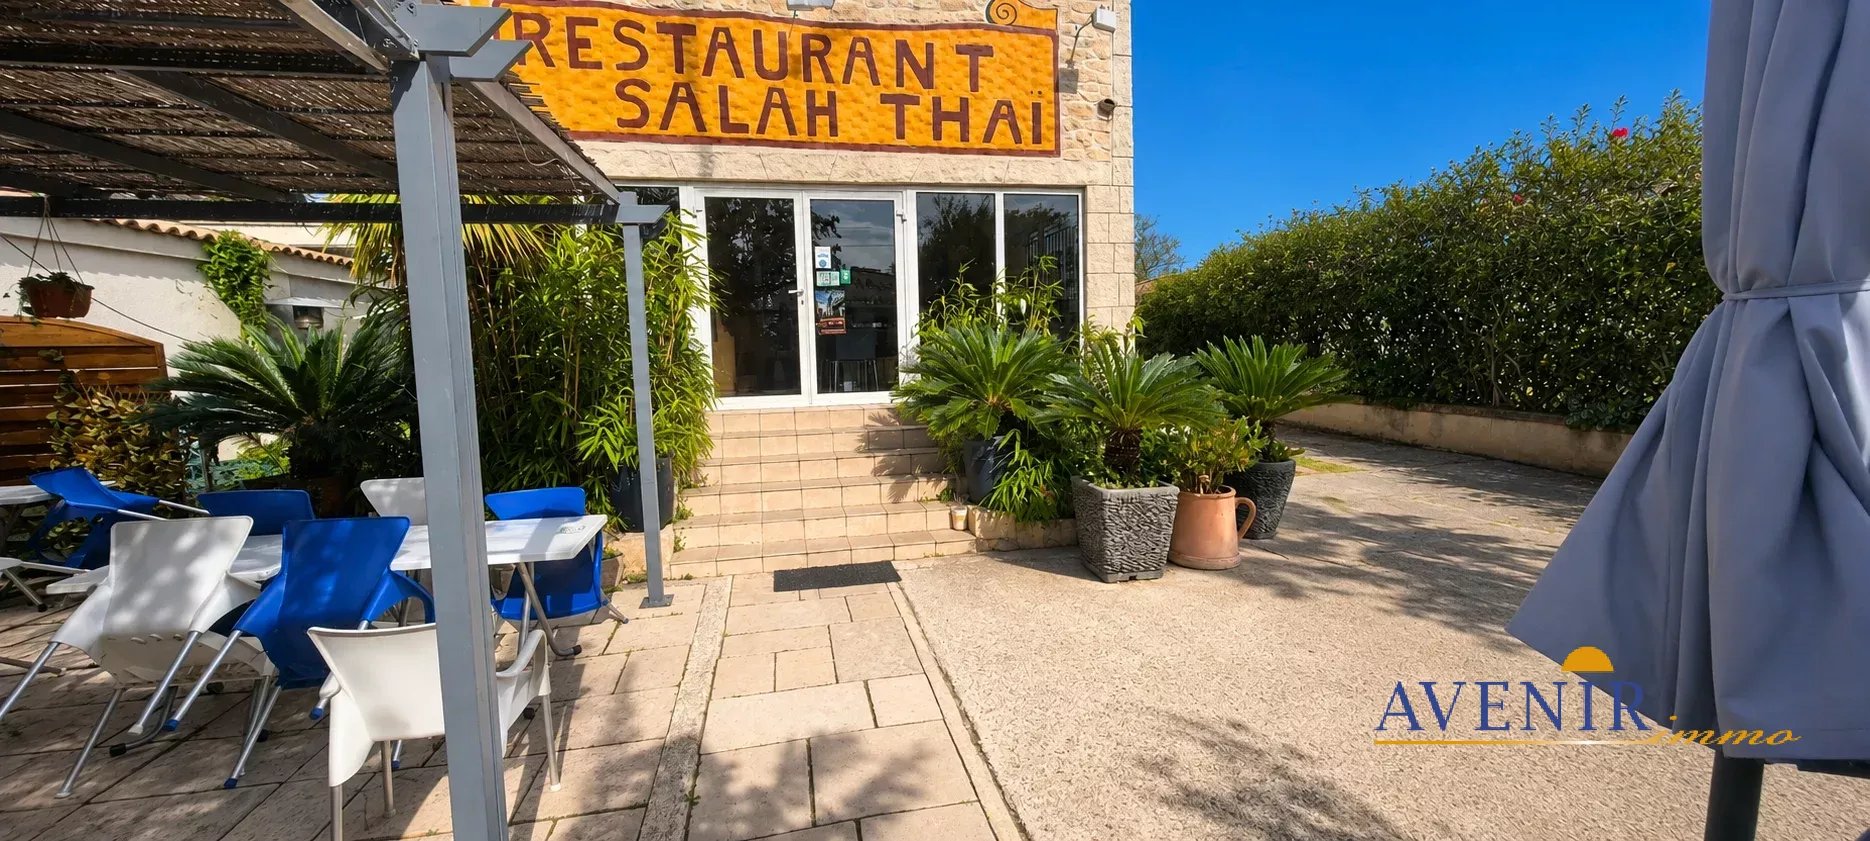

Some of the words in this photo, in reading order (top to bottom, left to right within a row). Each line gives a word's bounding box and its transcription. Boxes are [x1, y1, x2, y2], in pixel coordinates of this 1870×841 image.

[512, 13, 995, 93] RESTAURANT
[616, 78, 838, 138] SALAH
[879, 91, 1043, 145] THAÏ
